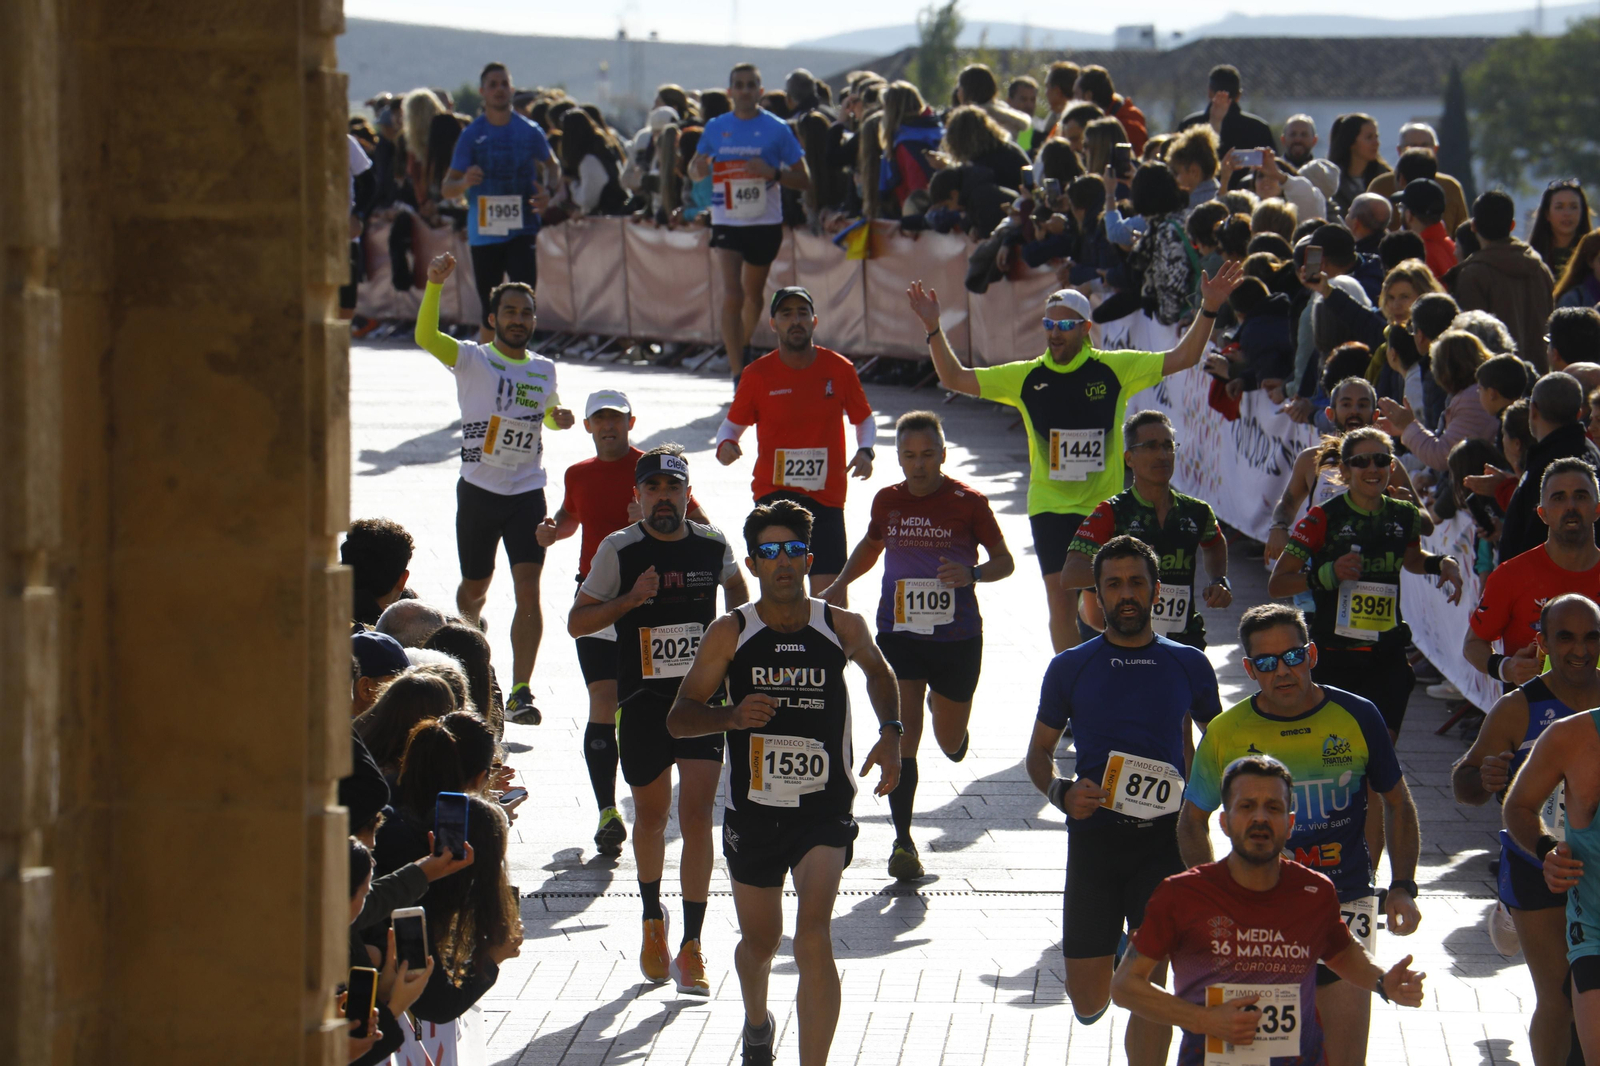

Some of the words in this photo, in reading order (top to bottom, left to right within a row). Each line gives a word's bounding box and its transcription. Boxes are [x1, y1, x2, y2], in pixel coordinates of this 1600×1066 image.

[735, 186, 760, 200] 469
[488, 204, 519, 217] 1905
[515, 397, 538, 410] FUEGO
[502, 429, 534, 450] 512
[1060, 440, 1101, 458] 1442
[785, 459, 825, 476] 2237
[901, 517, 932, 527] MEDIA
[887, 526, 897, 536] 36
[899, 526, 952, 538] MARATÓN
[906, 591, 951, 610] 1109
[1351, 595, 1392, 617] 3951
[658, 626, 684, 634] IMDECO
[651, 636, 701, 660] 2025
[751, 666, 826, 687] RUYJU
[773, 739, 805, 748] IMDECO
[765, 750, 824, 778] 1530
[1133, 760, 1163, 773] IMDECO
[1322, 755, 1353, 765] TRIATLÓN
[1125, 773, 1171, 804] 870
[1308, 822, 1328, 830] vive
[1236, 928, 1285, 942] MEDIA
[1210, 940, 1231, 955] 36
[1236, 941, 1310, 959] MARATÓN
